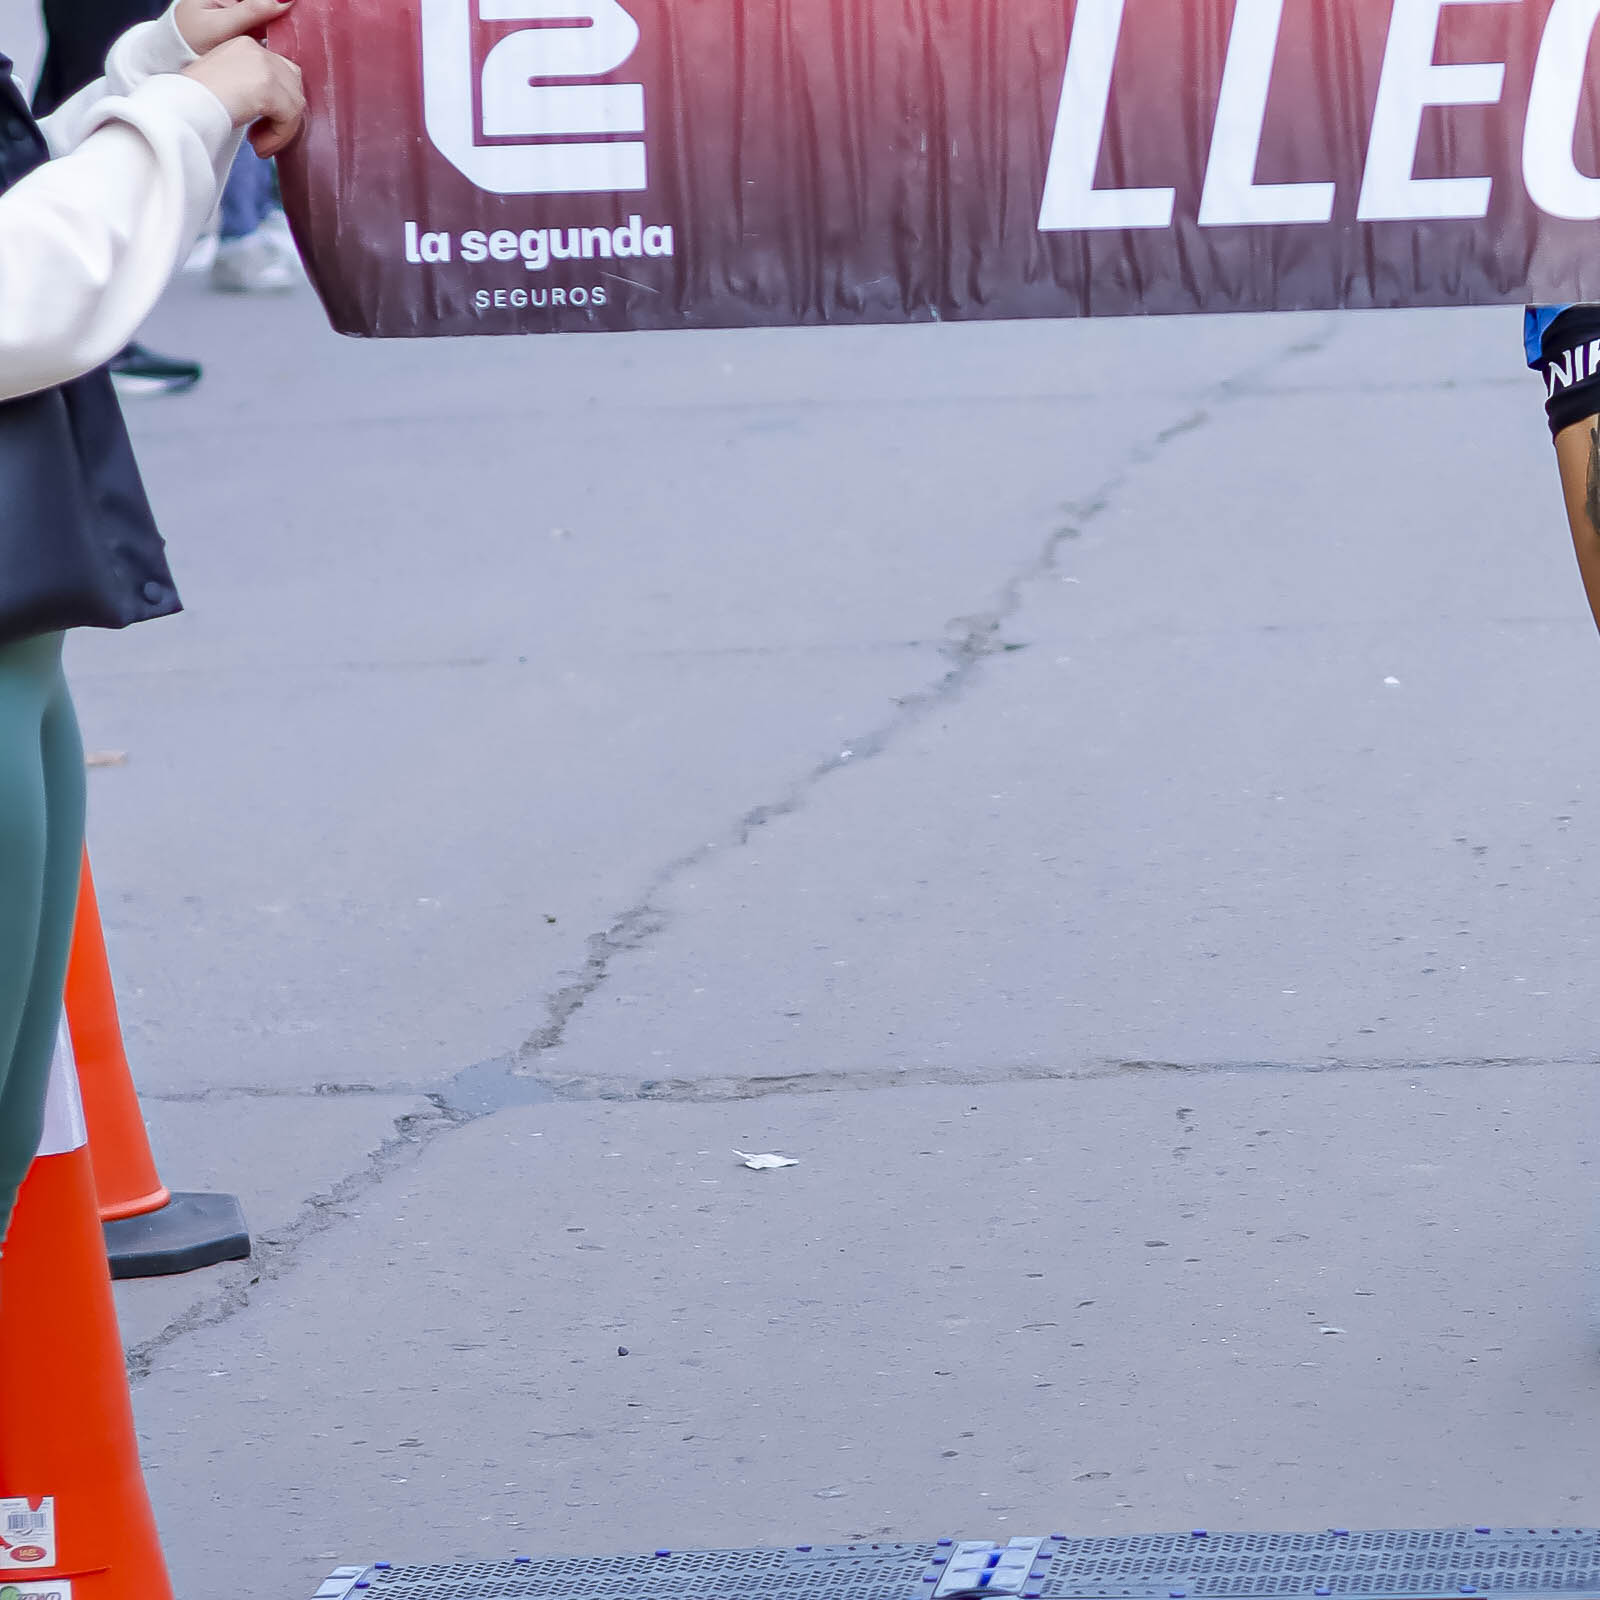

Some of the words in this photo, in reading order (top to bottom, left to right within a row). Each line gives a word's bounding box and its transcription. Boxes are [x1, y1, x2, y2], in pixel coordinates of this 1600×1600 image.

[404, 221, 451, 264] la
[461, 214, 674, 271] segunda
[475, 286, 608, 310] SEGUROS
